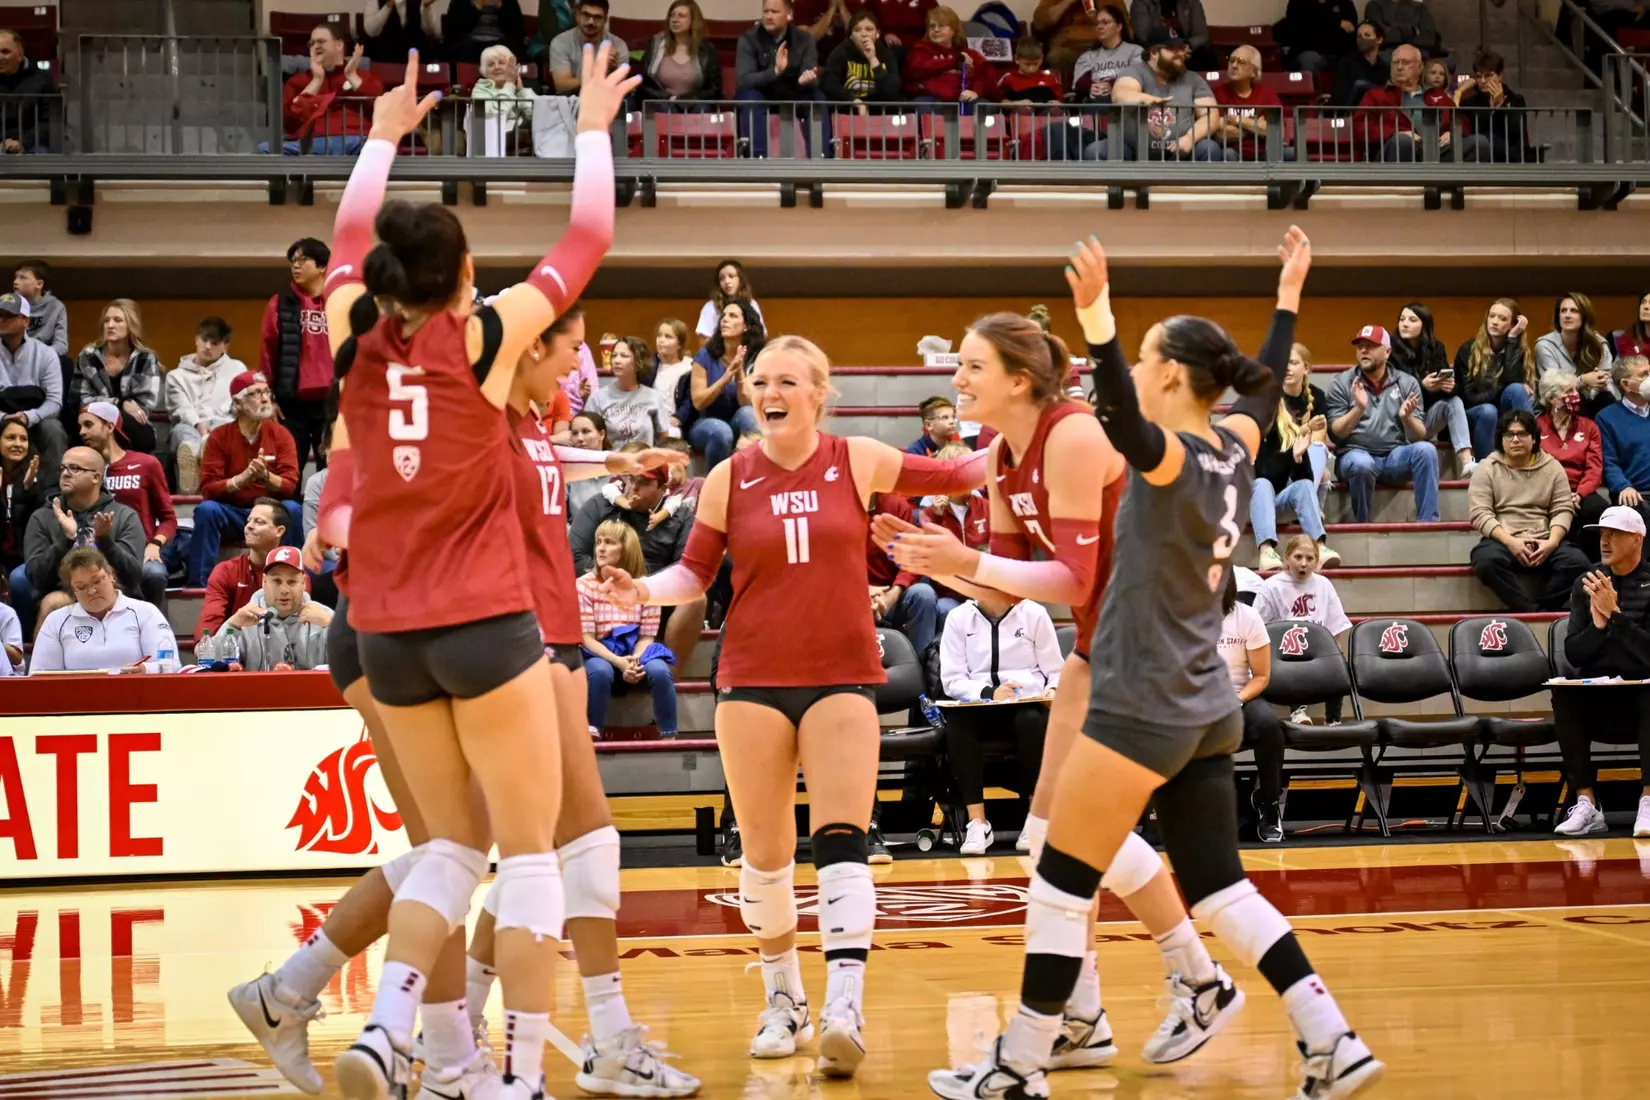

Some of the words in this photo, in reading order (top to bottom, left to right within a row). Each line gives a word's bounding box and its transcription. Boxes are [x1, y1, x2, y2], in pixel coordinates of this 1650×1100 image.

[386, 361, 429, 441] 5
[521, 438, 554, 462] WSU
[536, 465, 561, 515] 12
[770, 489, 819, 516] WSU
[1008, 492, 1039, 517] WSU
[782, 516, 810, 564] 11
[1023, 520, 1056, 553] 7
[1212, 484, 1240, 559] 3
